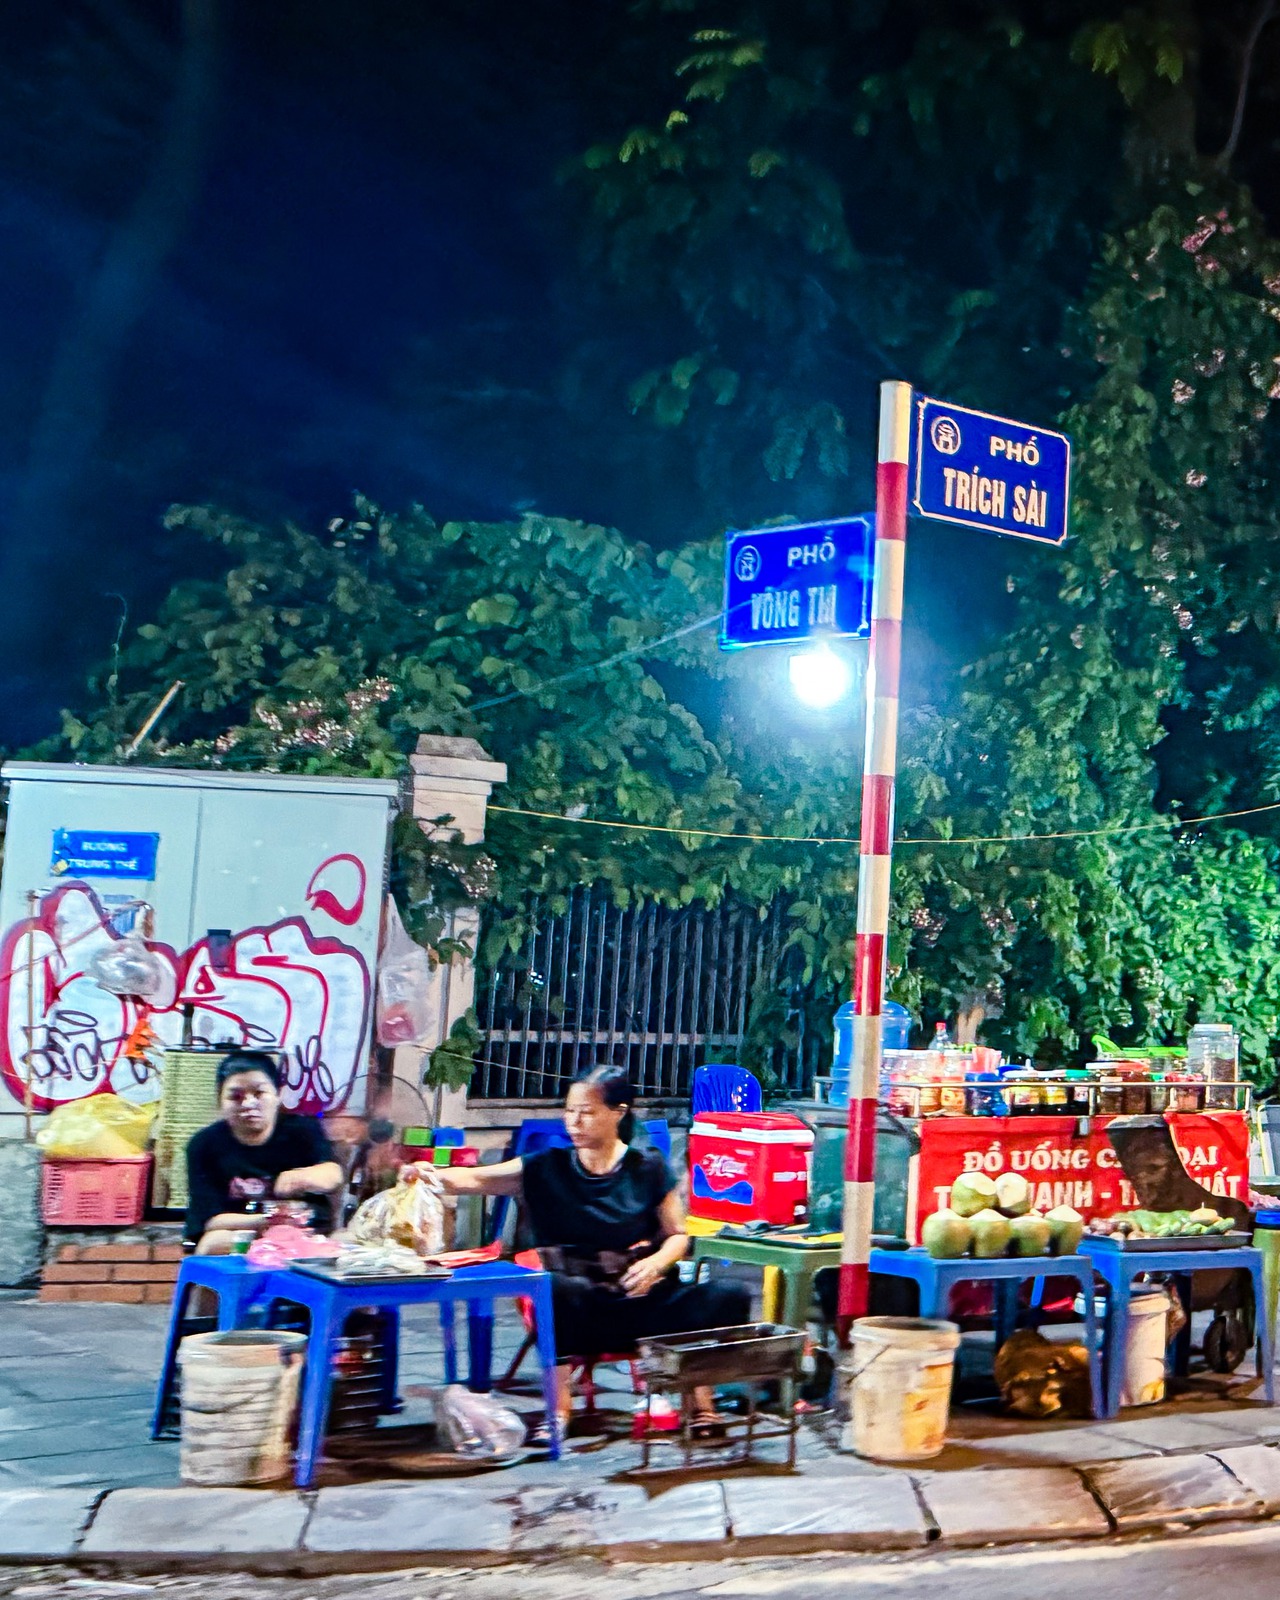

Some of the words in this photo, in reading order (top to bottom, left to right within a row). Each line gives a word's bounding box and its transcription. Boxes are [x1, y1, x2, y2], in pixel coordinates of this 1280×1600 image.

[990, 434, 1040, 466] PHỐ
[943, 466, 1005, 519] TRÍCH
[1012, 481, 1048, 528] SÀI
[787, 534, 836, 568] PHỐ
[963, 1141, 1003, 1172] ĐỒ
[1011, 1141, 1090, 1171] UỐNG
